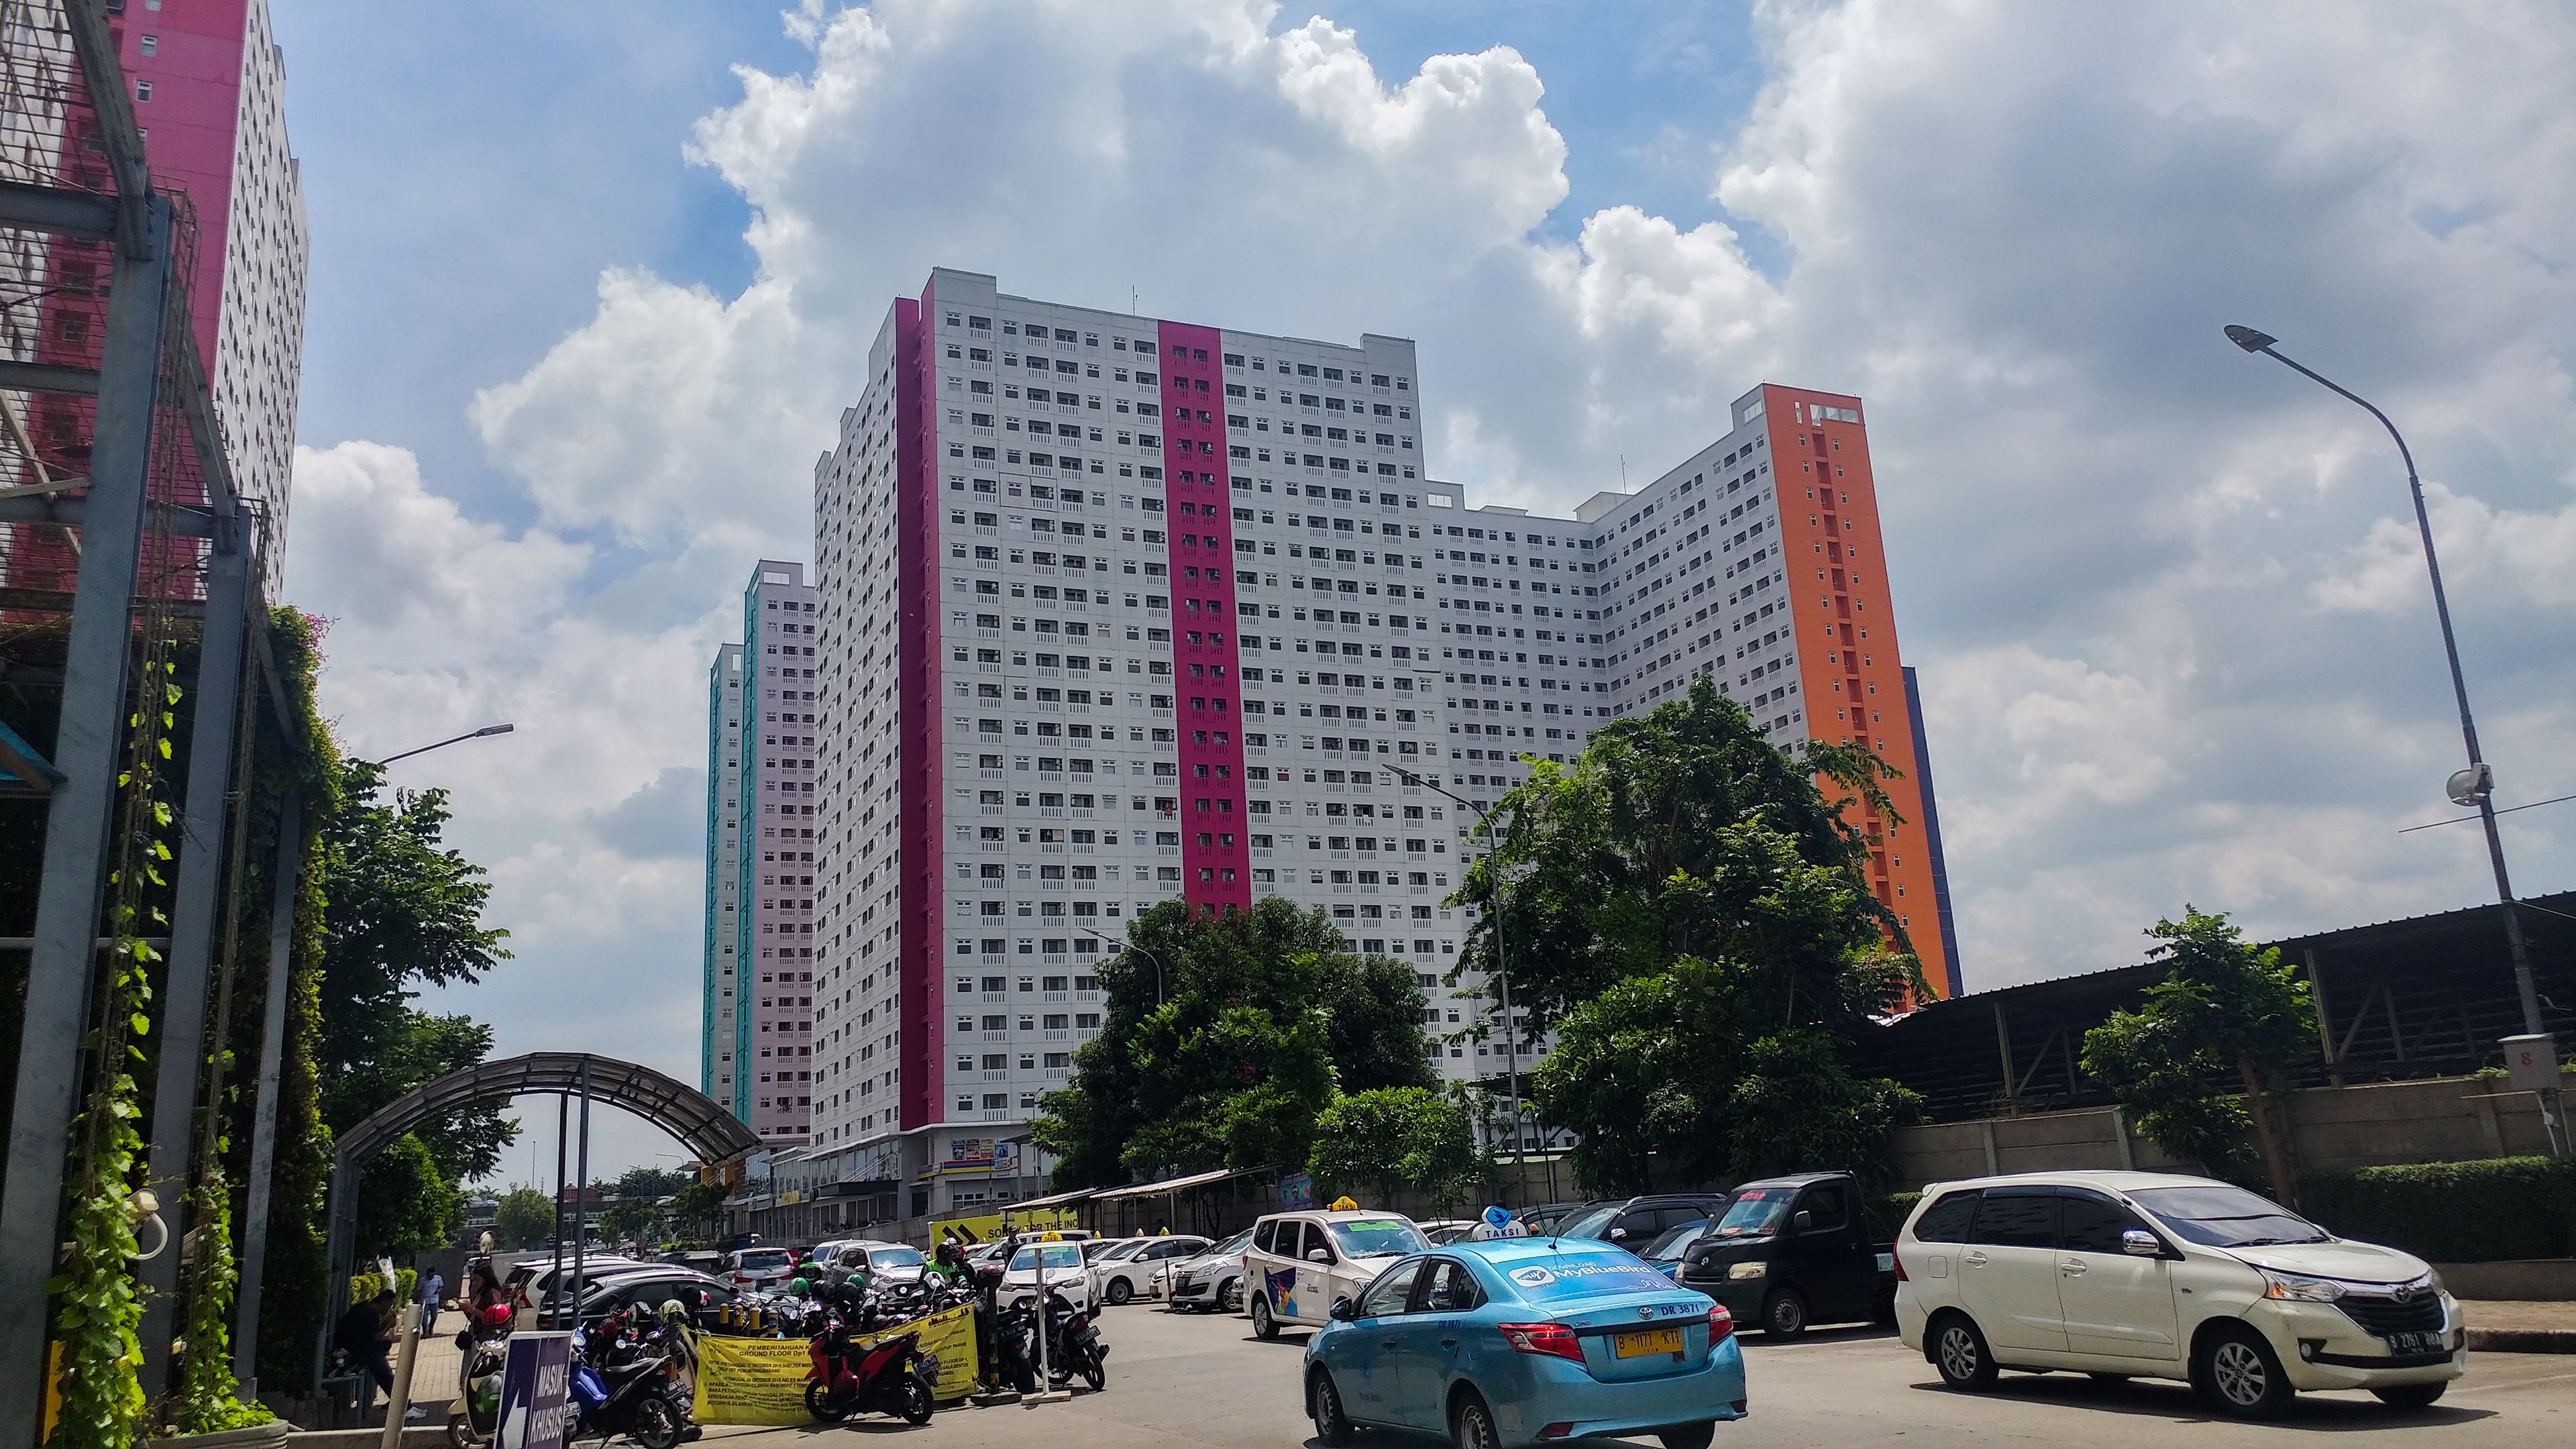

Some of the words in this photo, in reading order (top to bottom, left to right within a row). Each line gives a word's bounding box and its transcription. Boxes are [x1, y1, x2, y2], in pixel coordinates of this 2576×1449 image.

[2522, 1051, 2532, 1066] 8
[1045, 1221, 1063, 1231] THE
[1485, 1228, 1519, 1238] TAKSI
[1547, 1262, 1597, 1271] DOWNLOAD
[1661, 1306, 1676, 1316] DR
[1677, 1303, 1700, 1314] 3871
[1618, 1336, 1625, 1350] B
[2390, 1335, 2398, 1349] B
[2400, 1333, 2420, 1348] 2761
[537, 1363, 566, 1398] MASUK
[529, 1405, 563, 1444] KHUSUS
